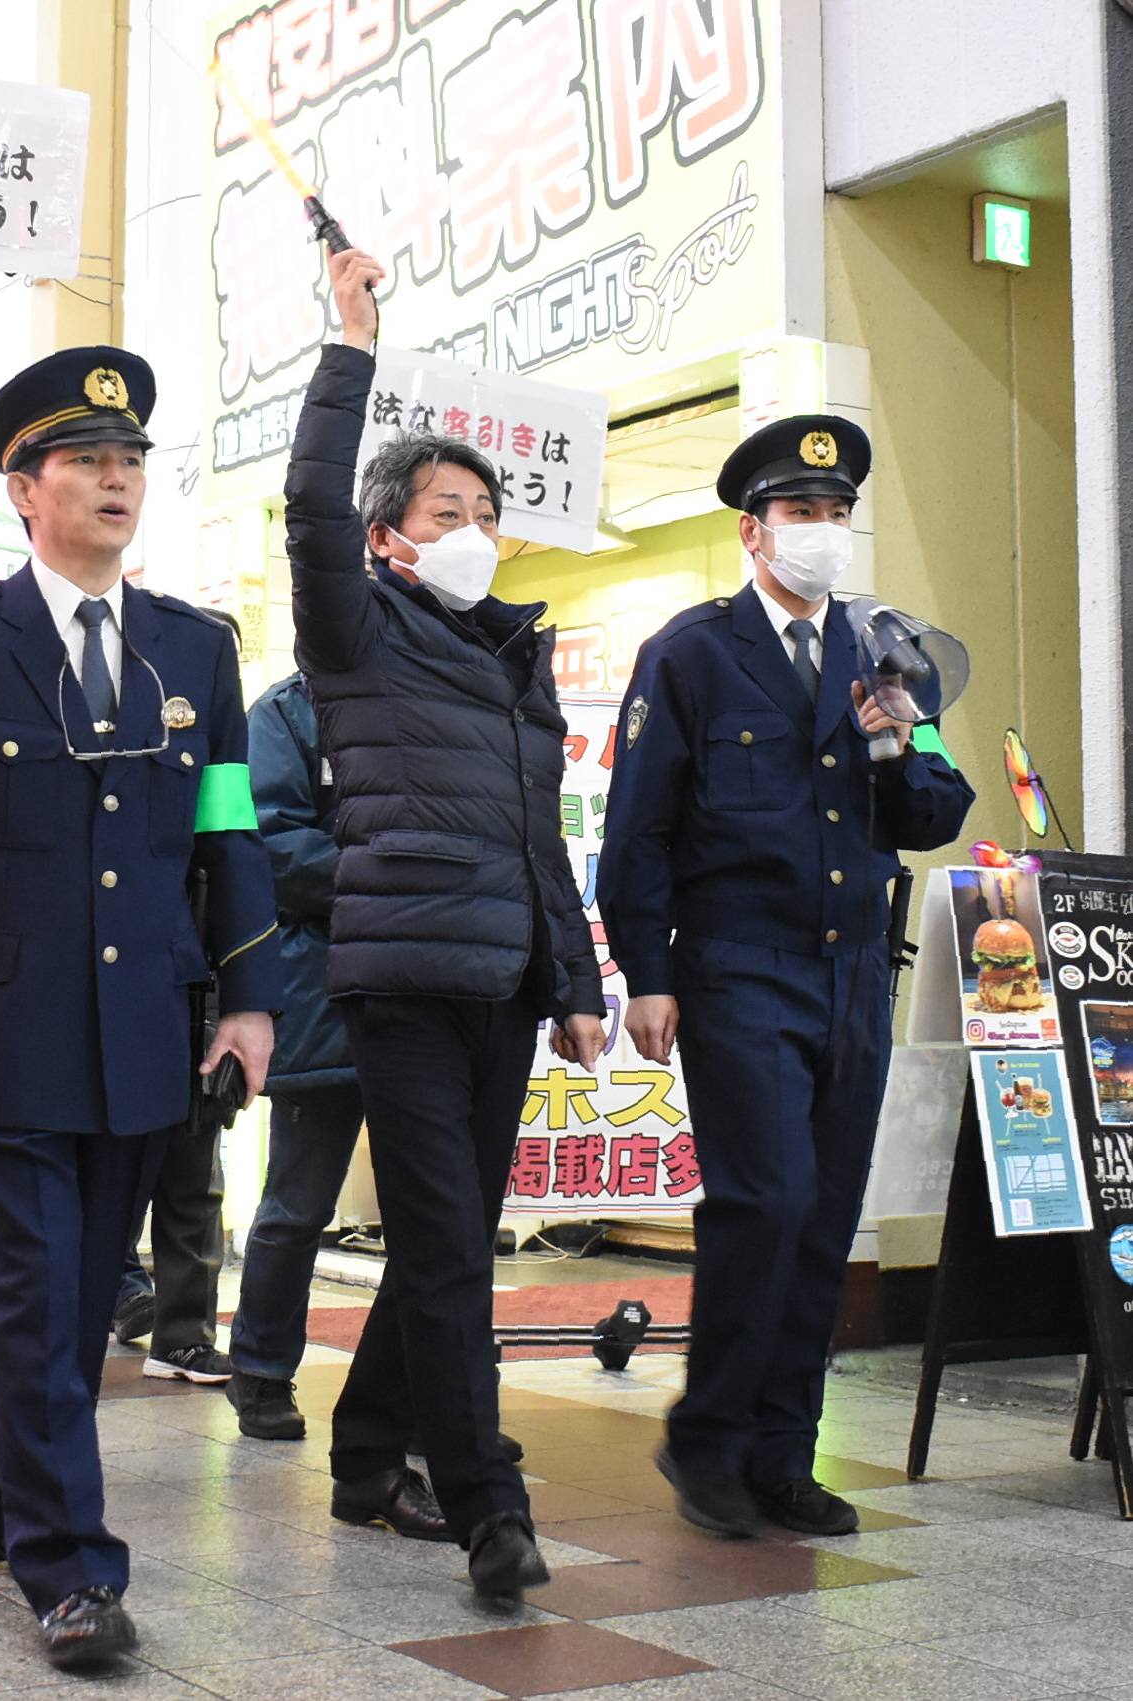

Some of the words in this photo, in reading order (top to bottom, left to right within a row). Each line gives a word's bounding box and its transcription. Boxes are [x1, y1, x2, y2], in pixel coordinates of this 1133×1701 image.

[492, 234, 645, 370] NIGHT
[616, 160, 760, 354] Spot
[1053, 893, 1076, 913] 2F
